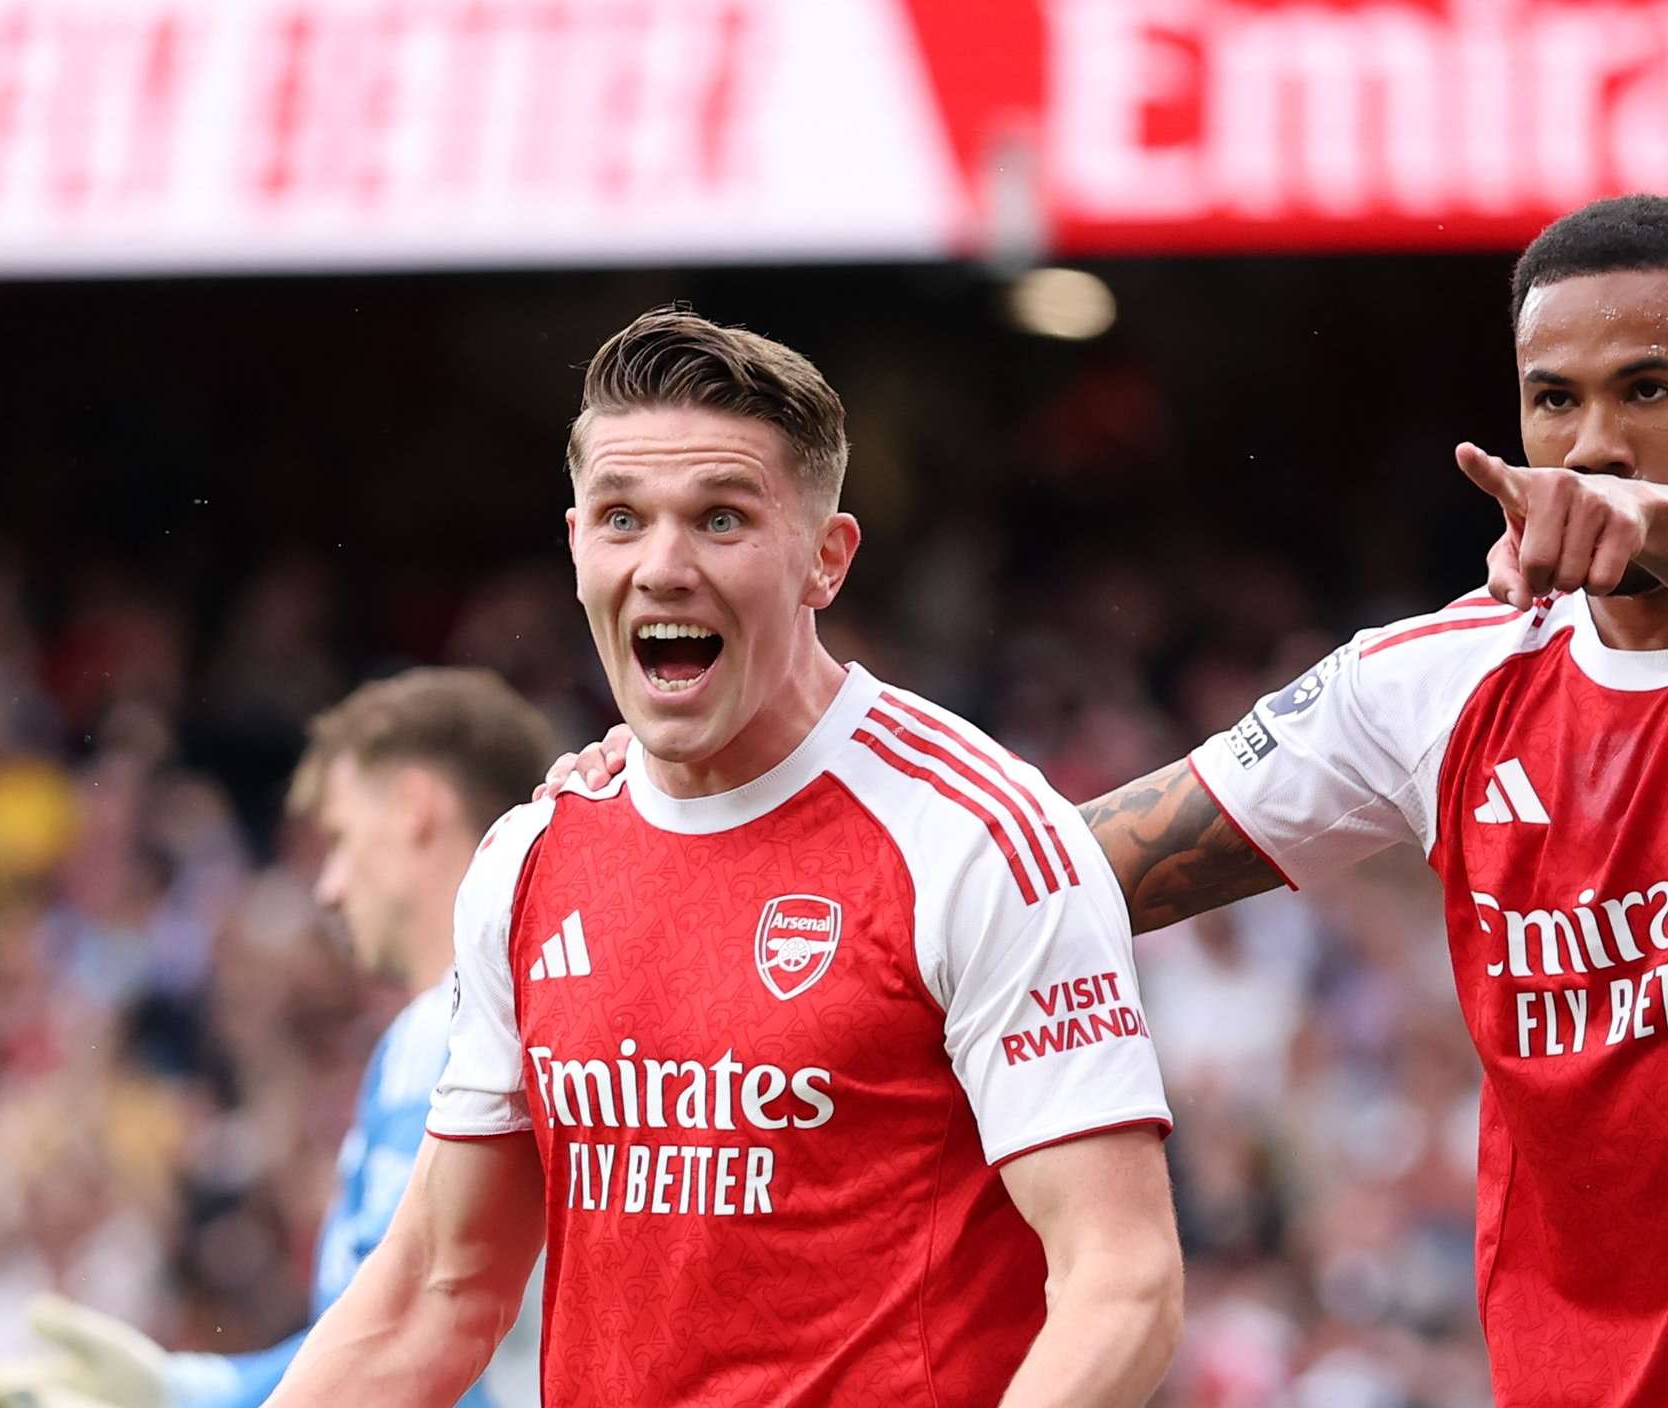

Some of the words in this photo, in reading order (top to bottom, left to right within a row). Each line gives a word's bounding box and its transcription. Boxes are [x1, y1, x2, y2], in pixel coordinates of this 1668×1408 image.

[770, 911, 831, 932] Arsenal
[1030, 972, 1121, 1017] VISIT
[1516, 989, 1587, 1058] FLY
[527, 1038, 835, 1130] Emirates
[567, 1142, 615, 1211] FLY
[624, 1145, 774, 1216] BETTER
